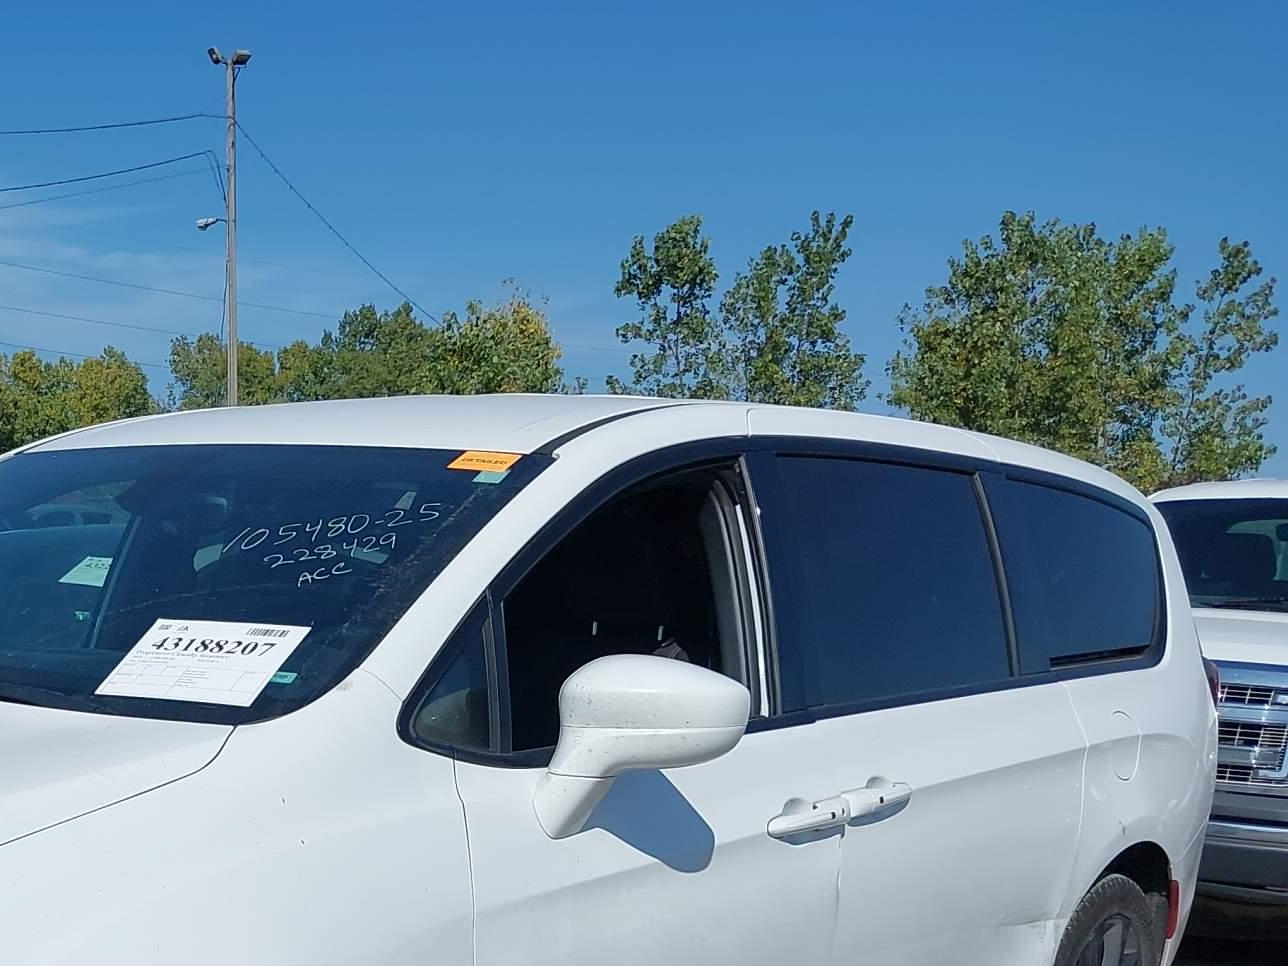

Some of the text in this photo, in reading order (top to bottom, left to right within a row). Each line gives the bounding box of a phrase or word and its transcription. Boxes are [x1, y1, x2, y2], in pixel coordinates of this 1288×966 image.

[263, 532, 397, 568] 228429
[296, 562, 353, 588] ACC
[151, 636, 278, 657] 43188207
